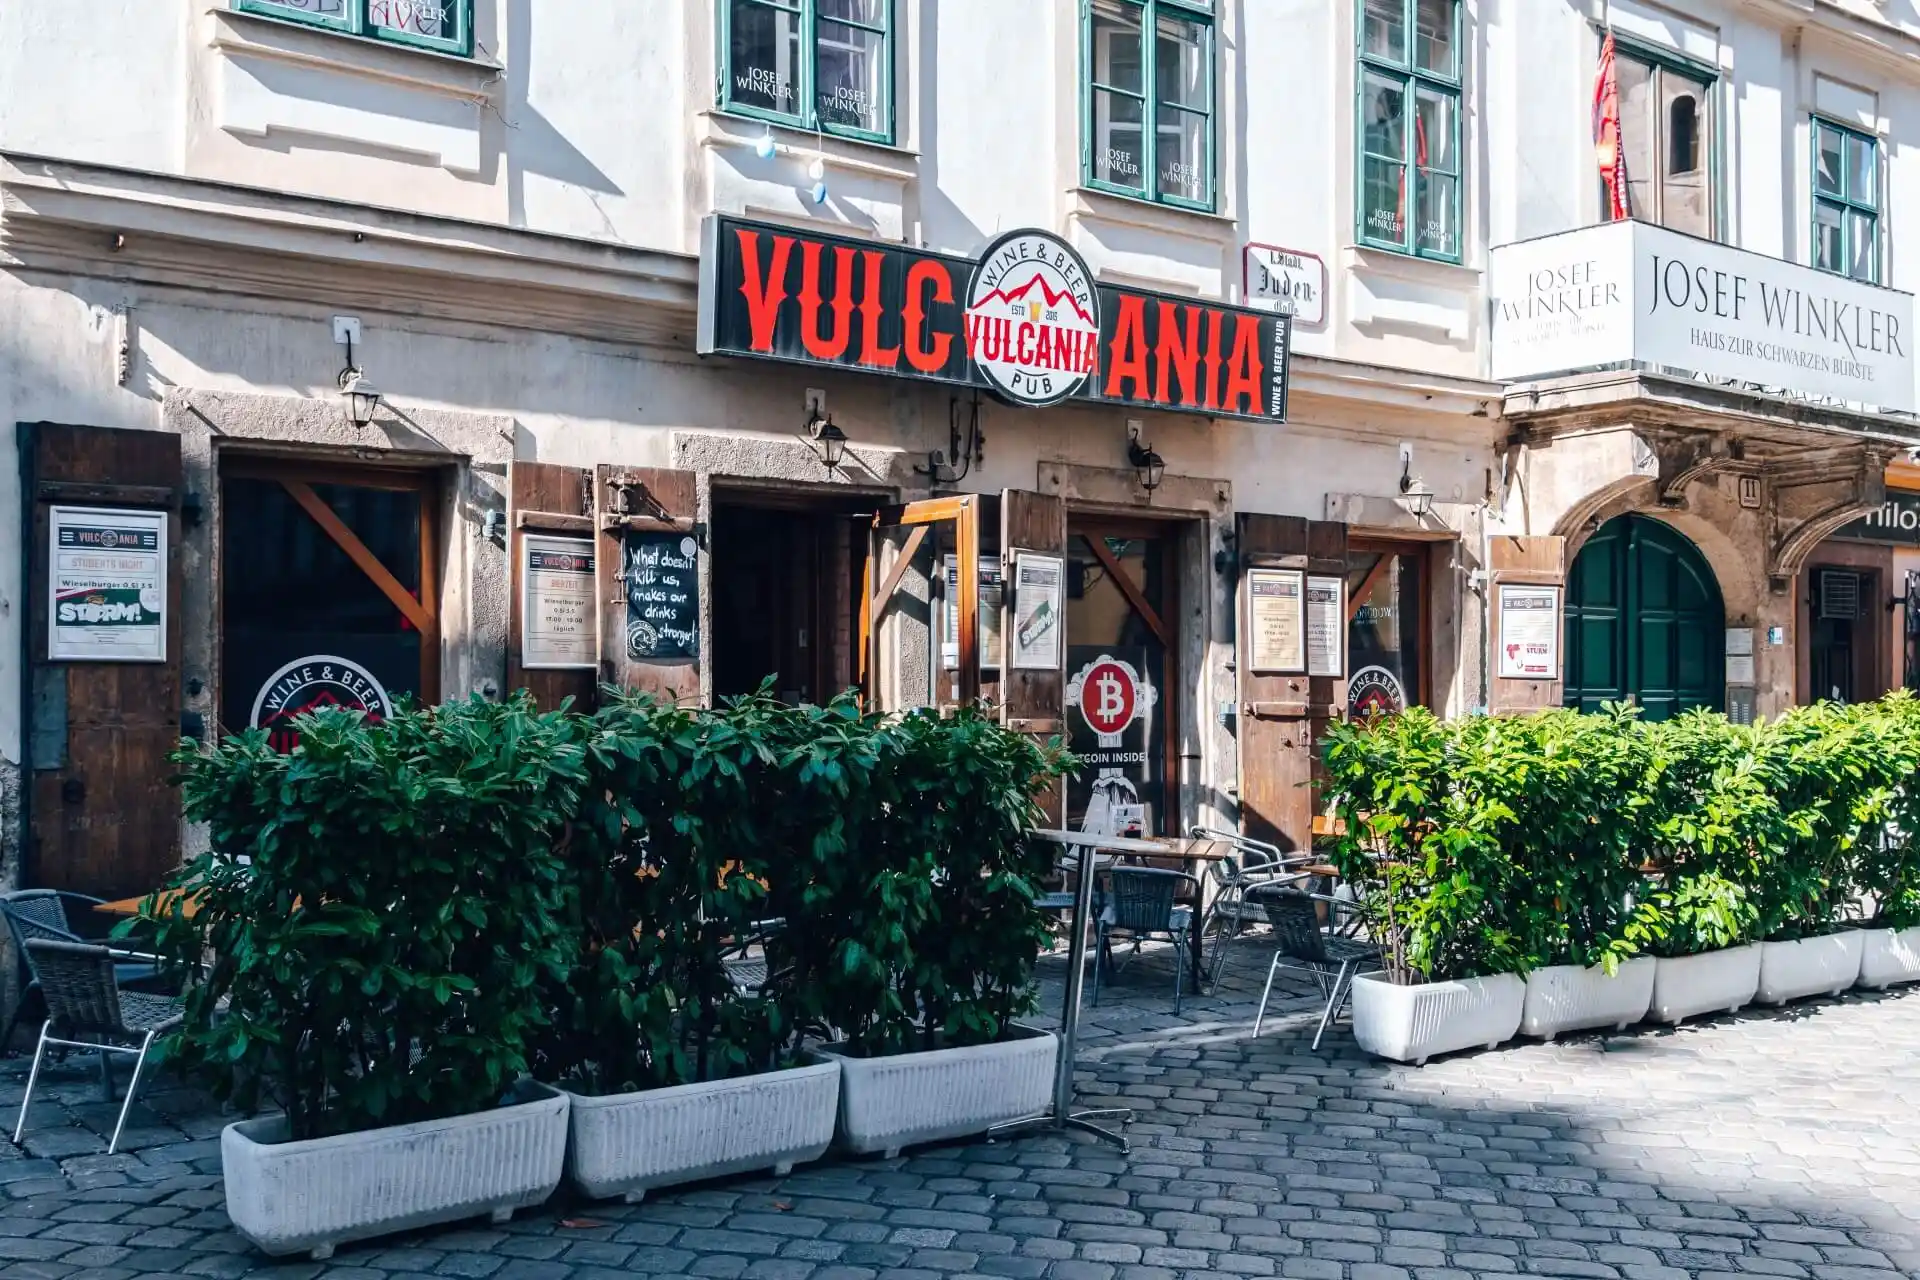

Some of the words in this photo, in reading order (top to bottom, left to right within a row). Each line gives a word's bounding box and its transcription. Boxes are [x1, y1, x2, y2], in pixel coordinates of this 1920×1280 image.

[749, 66, 782, 85] JOSEF
[736, 75, 794, 100] WINKLER
[835, 85, 865, 102] JOSEF
[1096, 155, 1139, 176] WINKLER
[1105, 147, 1131, 163] JOSEF
[1367, 216, 1402, 233] WINKLER
[1374, 208, 1396, 222] JOSEF
[982, 242, 1029, 289] WINE
[1036, 243, 1048, 260] &
[1054, 252, 1088, 306] BEER
[1528, 260, 1597, 297] JOSEF
[1503, 282, 1620, 321] WINKLER
[1649, 255, 1747, 320] JOSEF
[1758, 281, 1905, 362] WINKLER
[1275, 320, 1285, 343] PUB
[962, 312, 1100, 376] VULCANIA
[1691, 327, 1725, 351] HAUS
[1728, 336, 1753, 357] ZUR
[1757, 342, 1829, 372] SCHWARZEN
[1833, 356, 1874, 382] BÜRSTE
[1273, 343, 1284, 374] BEER
[1011, 373, 1053, 395] PUB
[1273, 374, 1283, 386] &
[1271, 385, 1284, 416] WINE
[1745, 480, 1756, 497] 11
[630, 546, 658, 566] What
[635, 568, 656, 585] kill
[663, 575, 680, 587] us,
[634, 588, 666, 602] makes
[670, 593, 687, 603] our
[645, 603, 677, 620] drinks
[265, 667, 314, 709] WINE
[321, 665, 335, 680] &
[341, 670, 381, 712] BEER
[1348, 673, 1370, 702] WINE
[1373, 672, 1378, 681] &
[1382, 675, 1400, 705] BEER
[1112, 751, 1146, 763] INSIDE
